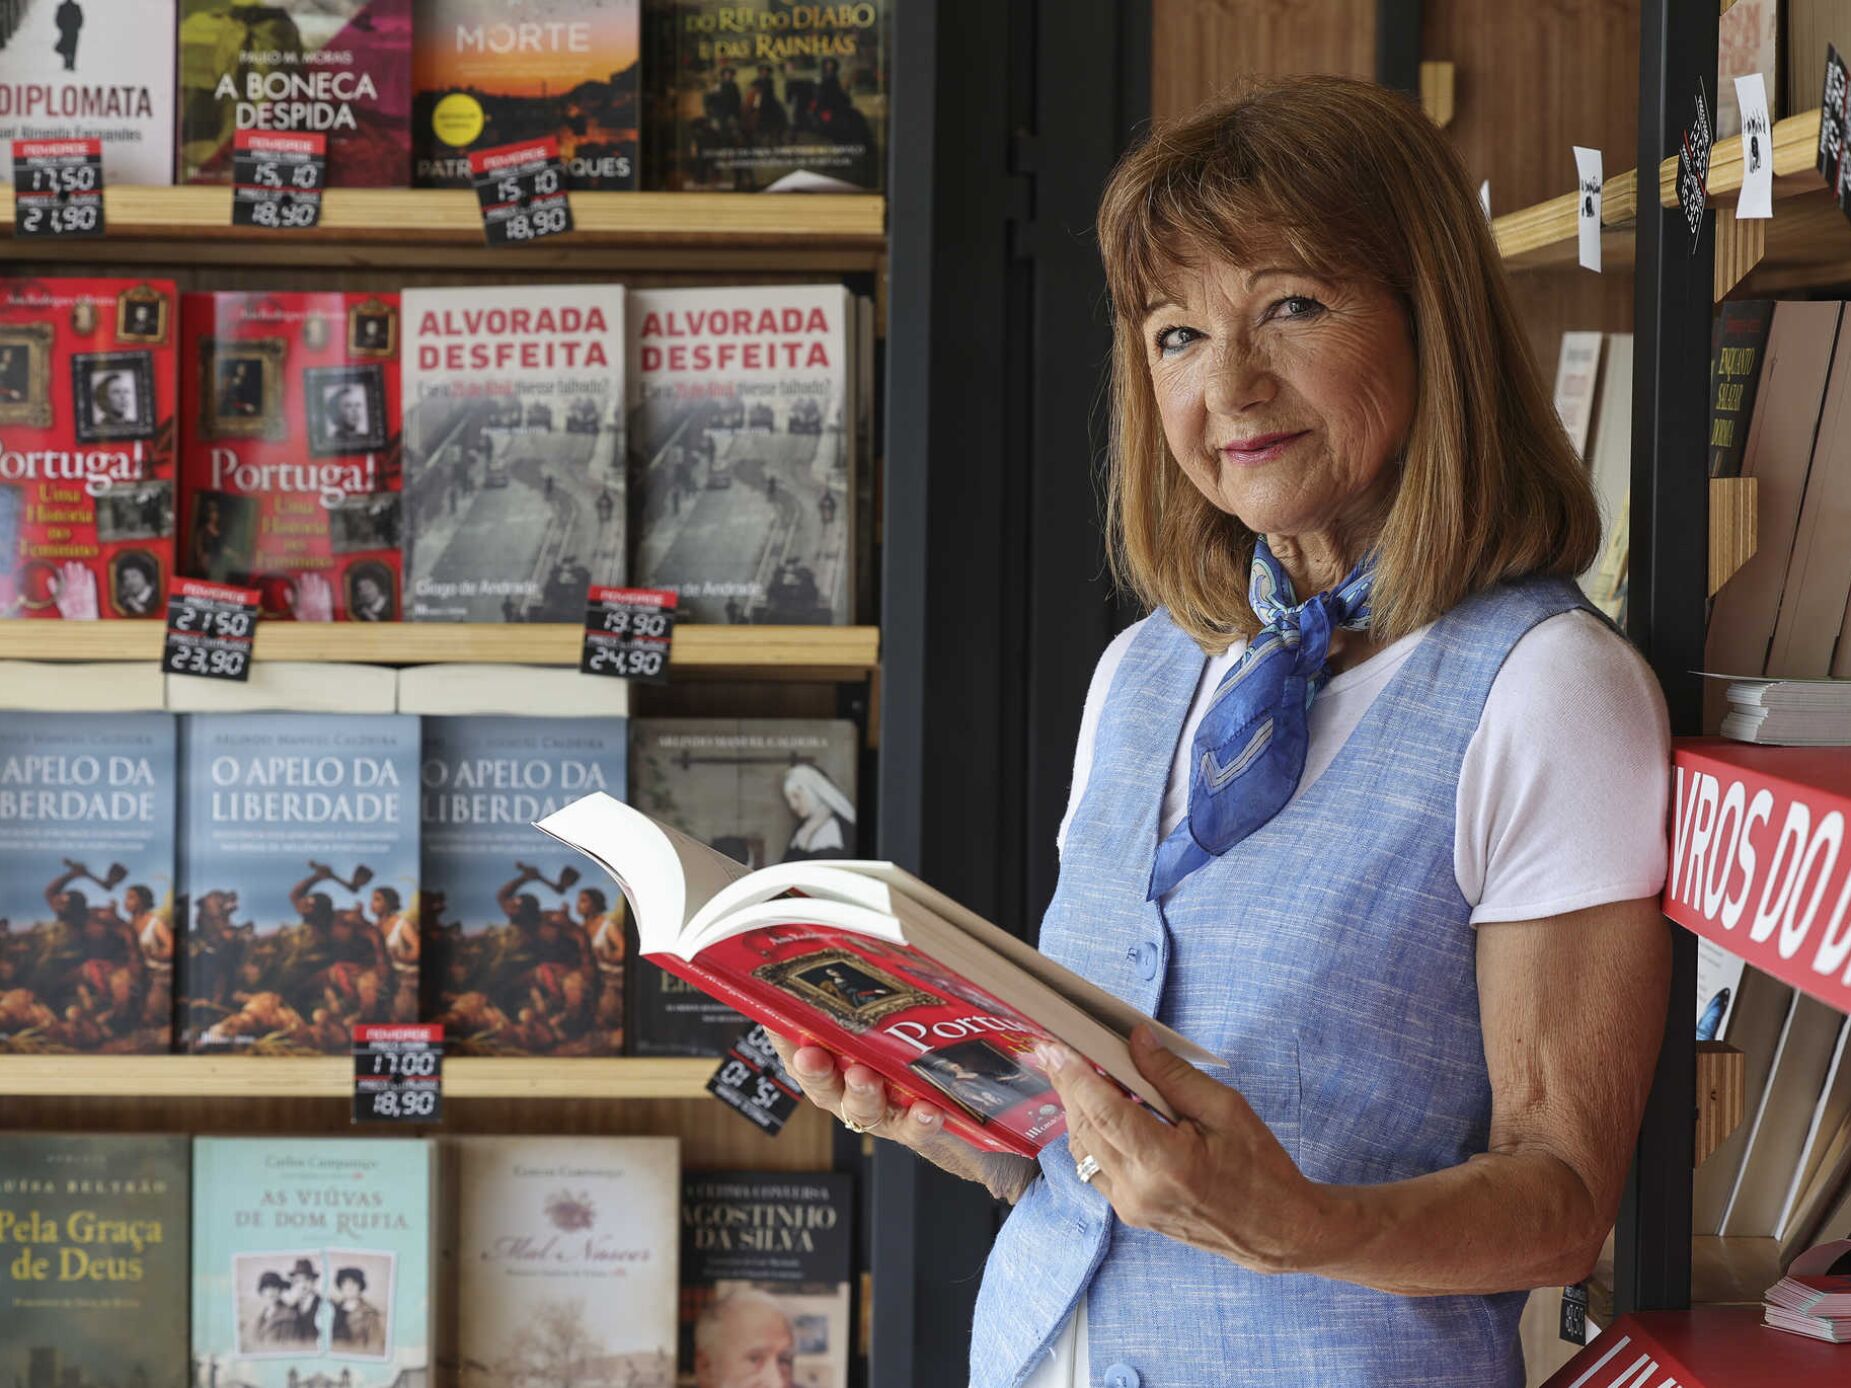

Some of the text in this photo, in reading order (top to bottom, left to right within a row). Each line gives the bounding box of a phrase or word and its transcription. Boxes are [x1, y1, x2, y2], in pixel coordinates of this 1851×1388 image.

[760, 11, 790, 31] DO
[793, 3, 876, 29] DIABO
[455, 20, 592, 54] MORTE
[757, 33, 857, 63] RAINHAS
[0, 84, 154, 118] DIPLOMATA
[213, 71, 379, 101] A BONECA
[235, 101, 358, 131] DESPIDA
[498, 168, 557, 202] 1510
[418, 306, 608, 337] ALVORADA
[641, 306, 830, 338] ALVORADA
[418, 341, 608, 371] DESFEITA
[641, 341, 831, 373] DESFEITA
[0, 440, 143, 497] ortugal
[210, 443, 376, 510] Portugal
[176, 606, 249, 637] 2150
[604, 611, 666, 637] 1990
[171, 645, 245, 676] 23,90
[590, 646, 663, 676] 24,90
[0, 755, 155, 787] APELO DA
[211, 756, 400, 787] O APELO DA
[422, 759, 608, 790] O APELO DA
[0, 789, 155, 822] BERDADE
[211, 792, 400, 823] LIBERDADE
[1750, 800, 1845, 960] DO
[883, 1015, 1034, 1054] Portu
[374, 1052, 436, 1076] 1700
[373, 1090, 436, 1118] 18,90
[260, 1186, 385, 1208] AS VIÚVAS
[0, 1210, 164, 1254] Pela Graça
[234, 1211, 411, 1241] DE DOM RUFIA
[694, 1228, 815, 1252] DA SILVA
[11, 1247, 146, 1282] de Deus
